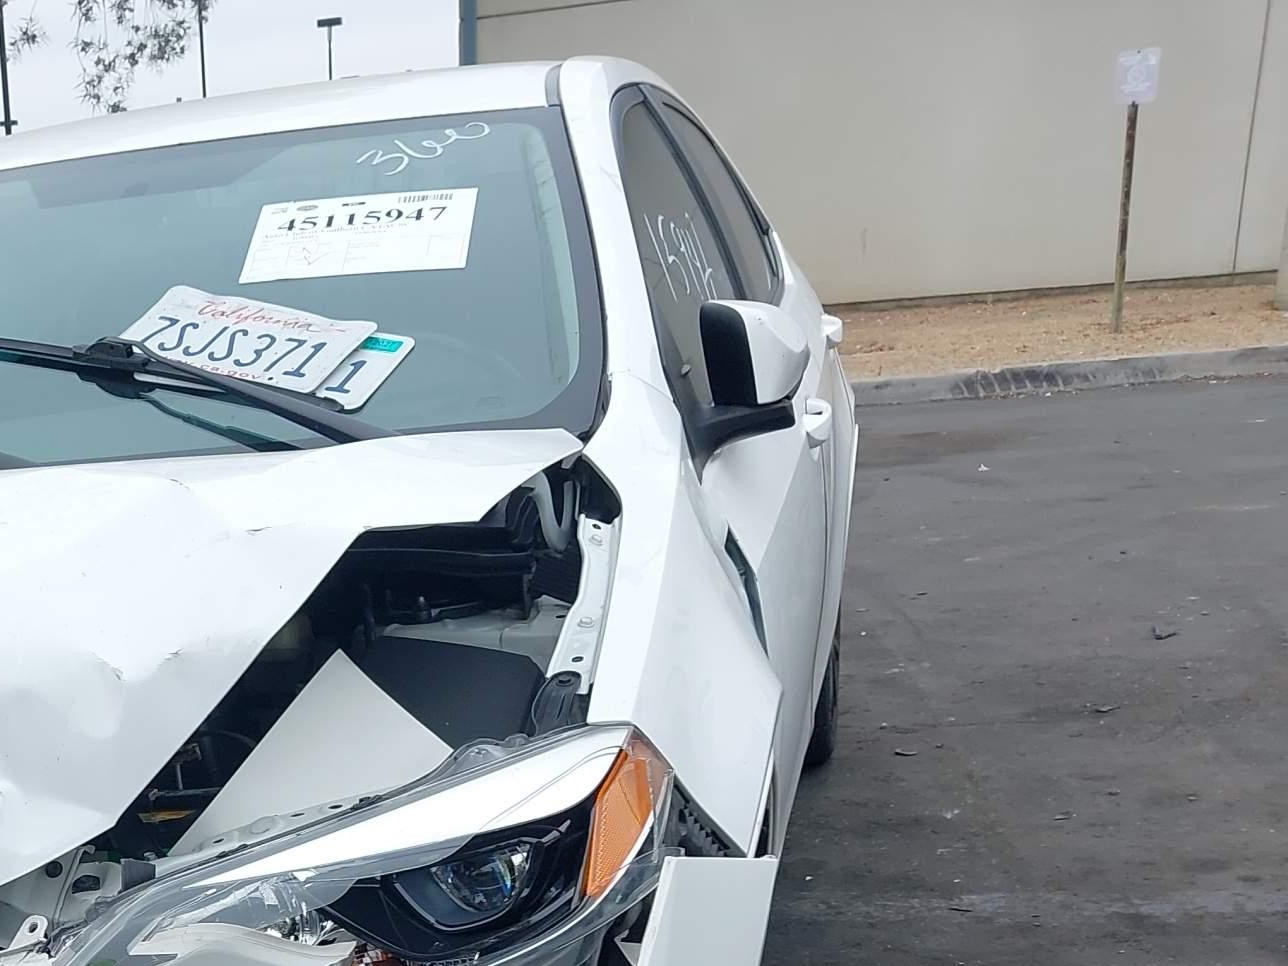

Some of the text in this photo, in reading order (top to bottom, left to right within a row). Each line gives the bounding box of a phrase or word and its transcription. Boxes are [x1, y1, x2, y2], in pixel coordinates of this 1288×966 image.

[277, 205, 448, 232] 45115947
[198, 300, 322, 334] California
[140, 315, 328, 379] 7SJS371
[324, 359, 368, 394] 1
